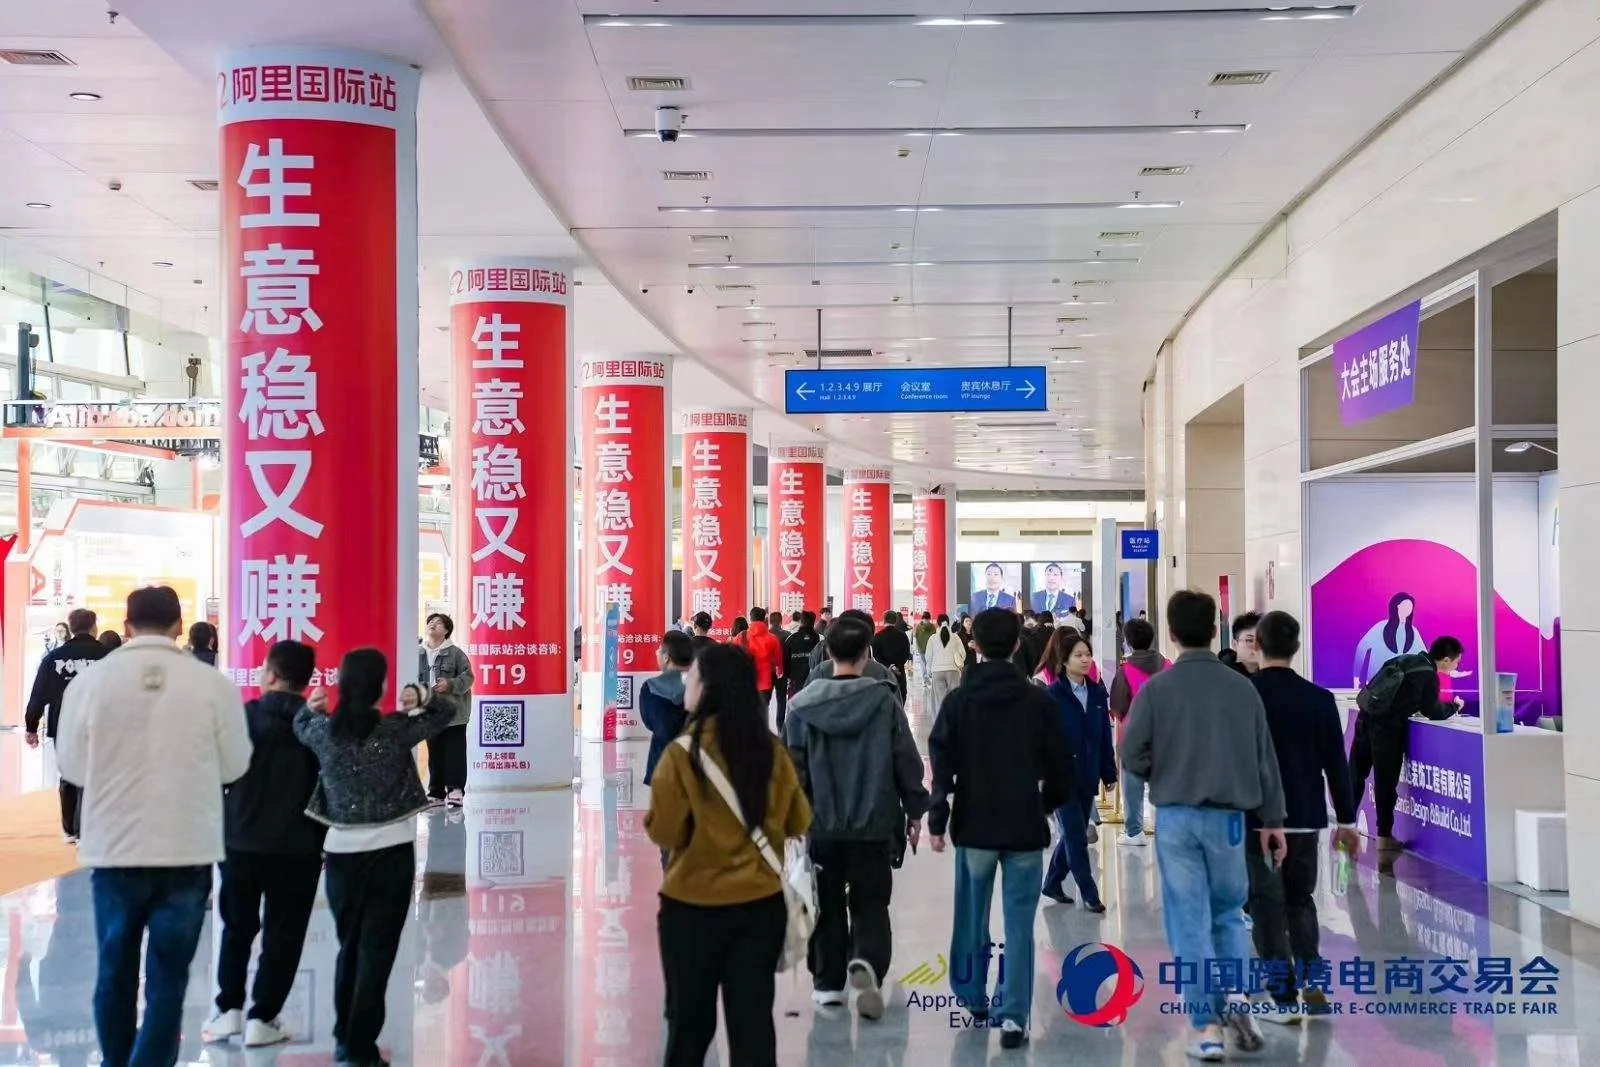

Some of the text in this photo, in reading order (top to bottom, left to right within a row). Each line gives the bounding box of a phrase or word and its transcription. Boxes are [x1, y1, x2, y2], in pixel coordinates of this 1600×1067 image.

[232, 65, 397, 112] 阿里国际站
[467, 268, 567, 295] 阿里国际站
[592, 361, 664, 379] 阿里国际站
[900, 381, 931, 392] 会议室
[960, 380, 1011, 392] 贵宾休息厅
[1341, 334, 1411, 402] 大会主场服务处
[237, 137, 325, 644] 生意稳又赚
[862, 382, 883, 392] 展厅
[971, 393, 991, 401] lounge
[691, 412, 747, 427] 阿里国际站
[471, 313, 527, 632] 生意稳又赚
[594, 393, 635, 626] 生意稳又赚
[691, 438, 723, 620] 生意稳又赚
[779, 467, 806, 617] 生意稳又赚
[852, 487, 874, 617] 生意稳又赚
[479, 663, 526, 686] T19
